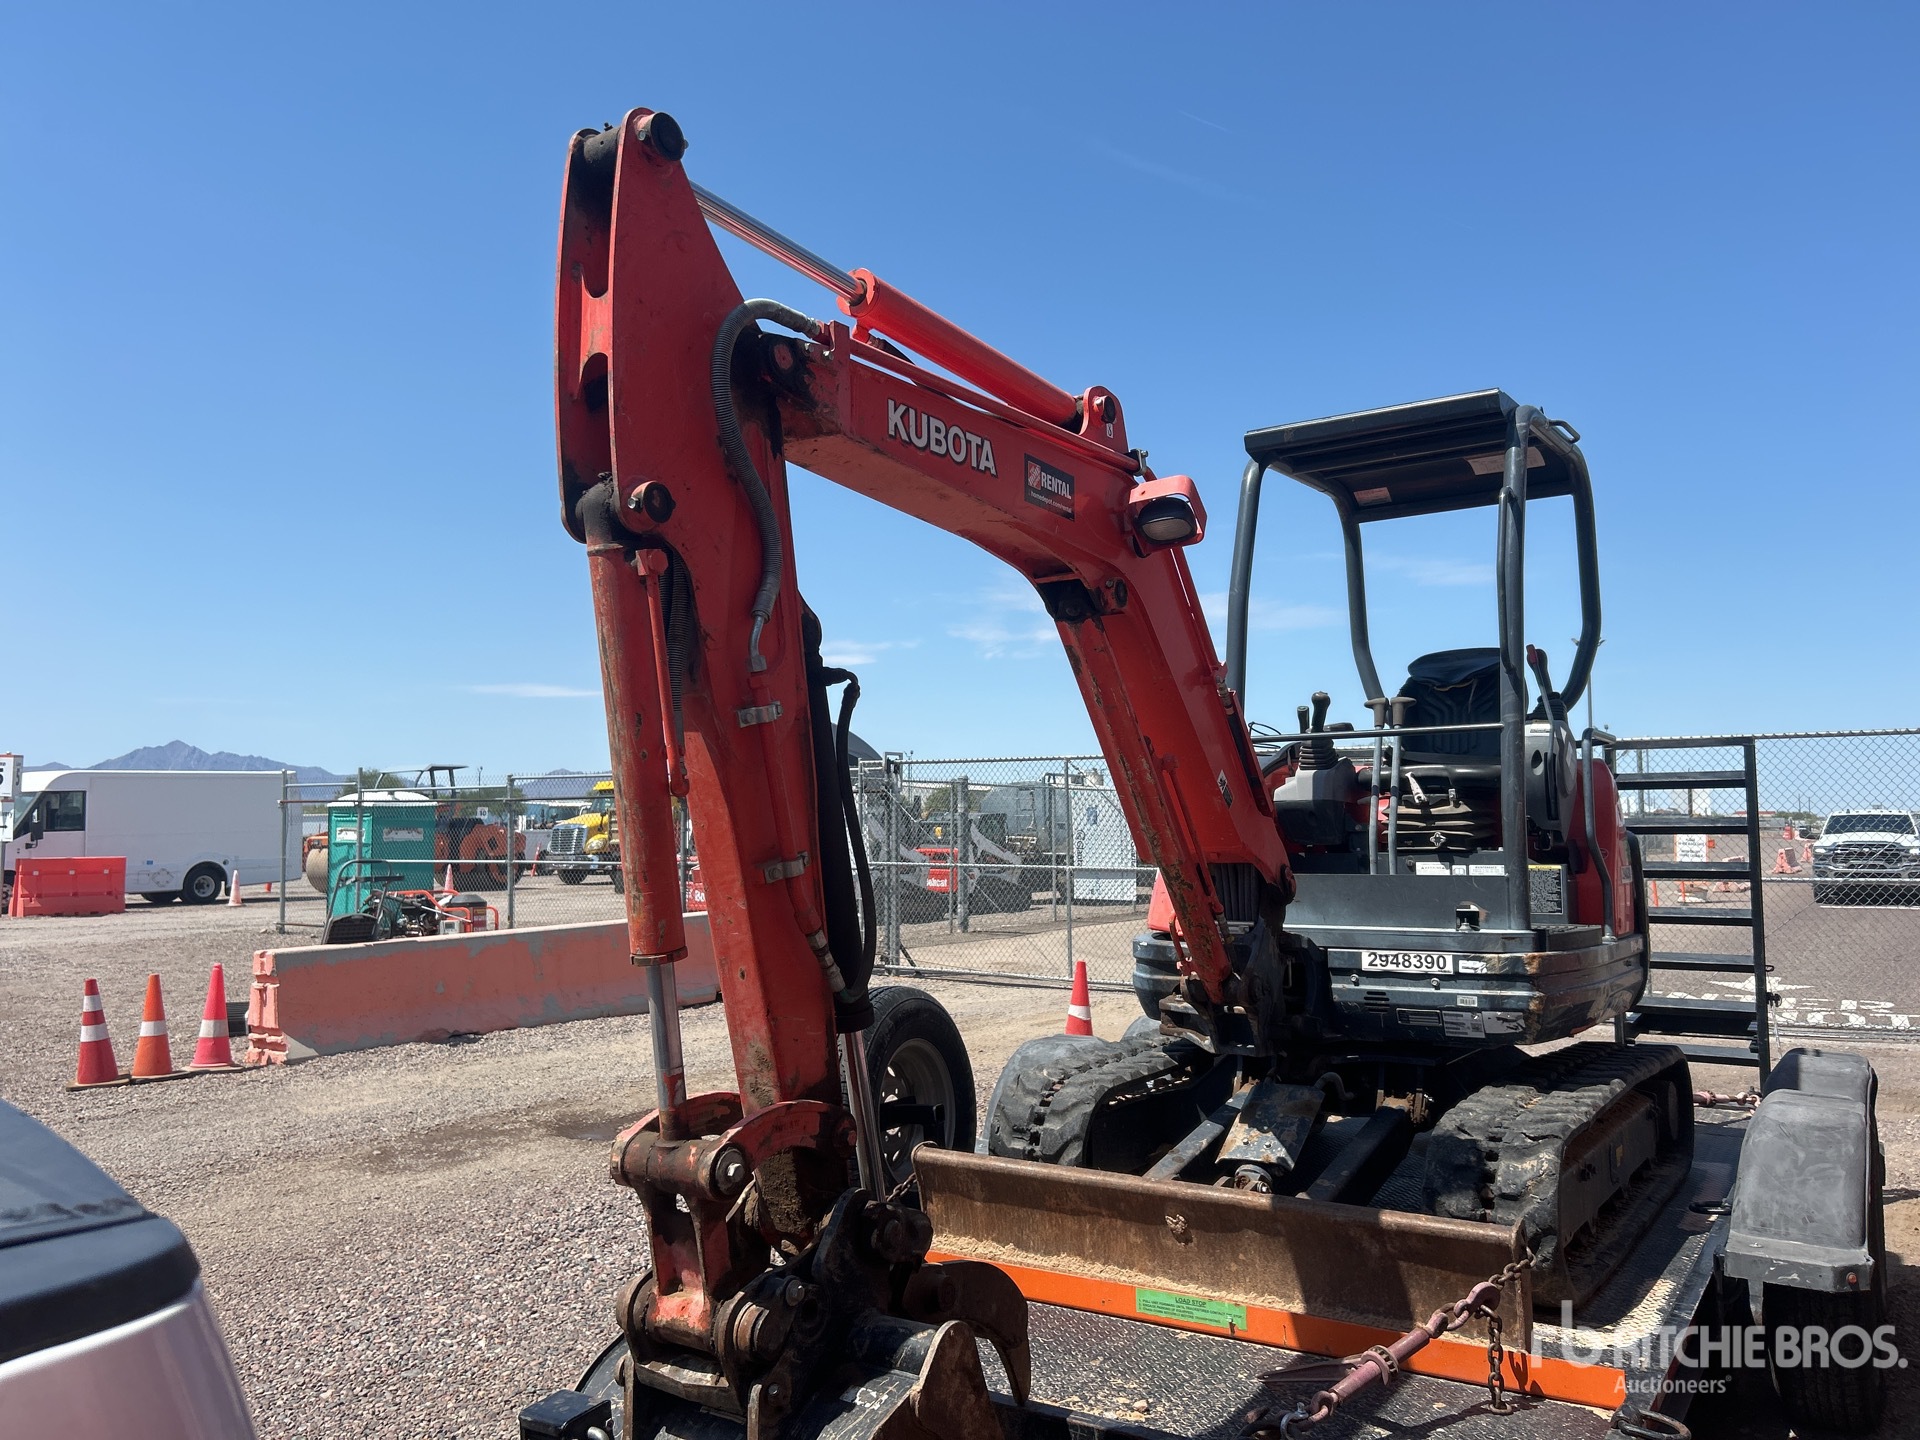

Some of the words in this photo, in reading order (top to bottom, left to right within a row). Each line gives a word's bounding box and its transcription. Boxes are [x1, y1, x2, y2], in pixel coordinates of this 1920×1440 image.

[887, 398, 998, 477] KUBOTA
[1041, 471, 1072, 500] RENTAL
[1367, 951, 1447, 970] 2948390
[1175, 1296, 1190, 1304] LOAD
[1191, 1299, 1206, 1307] STOP
